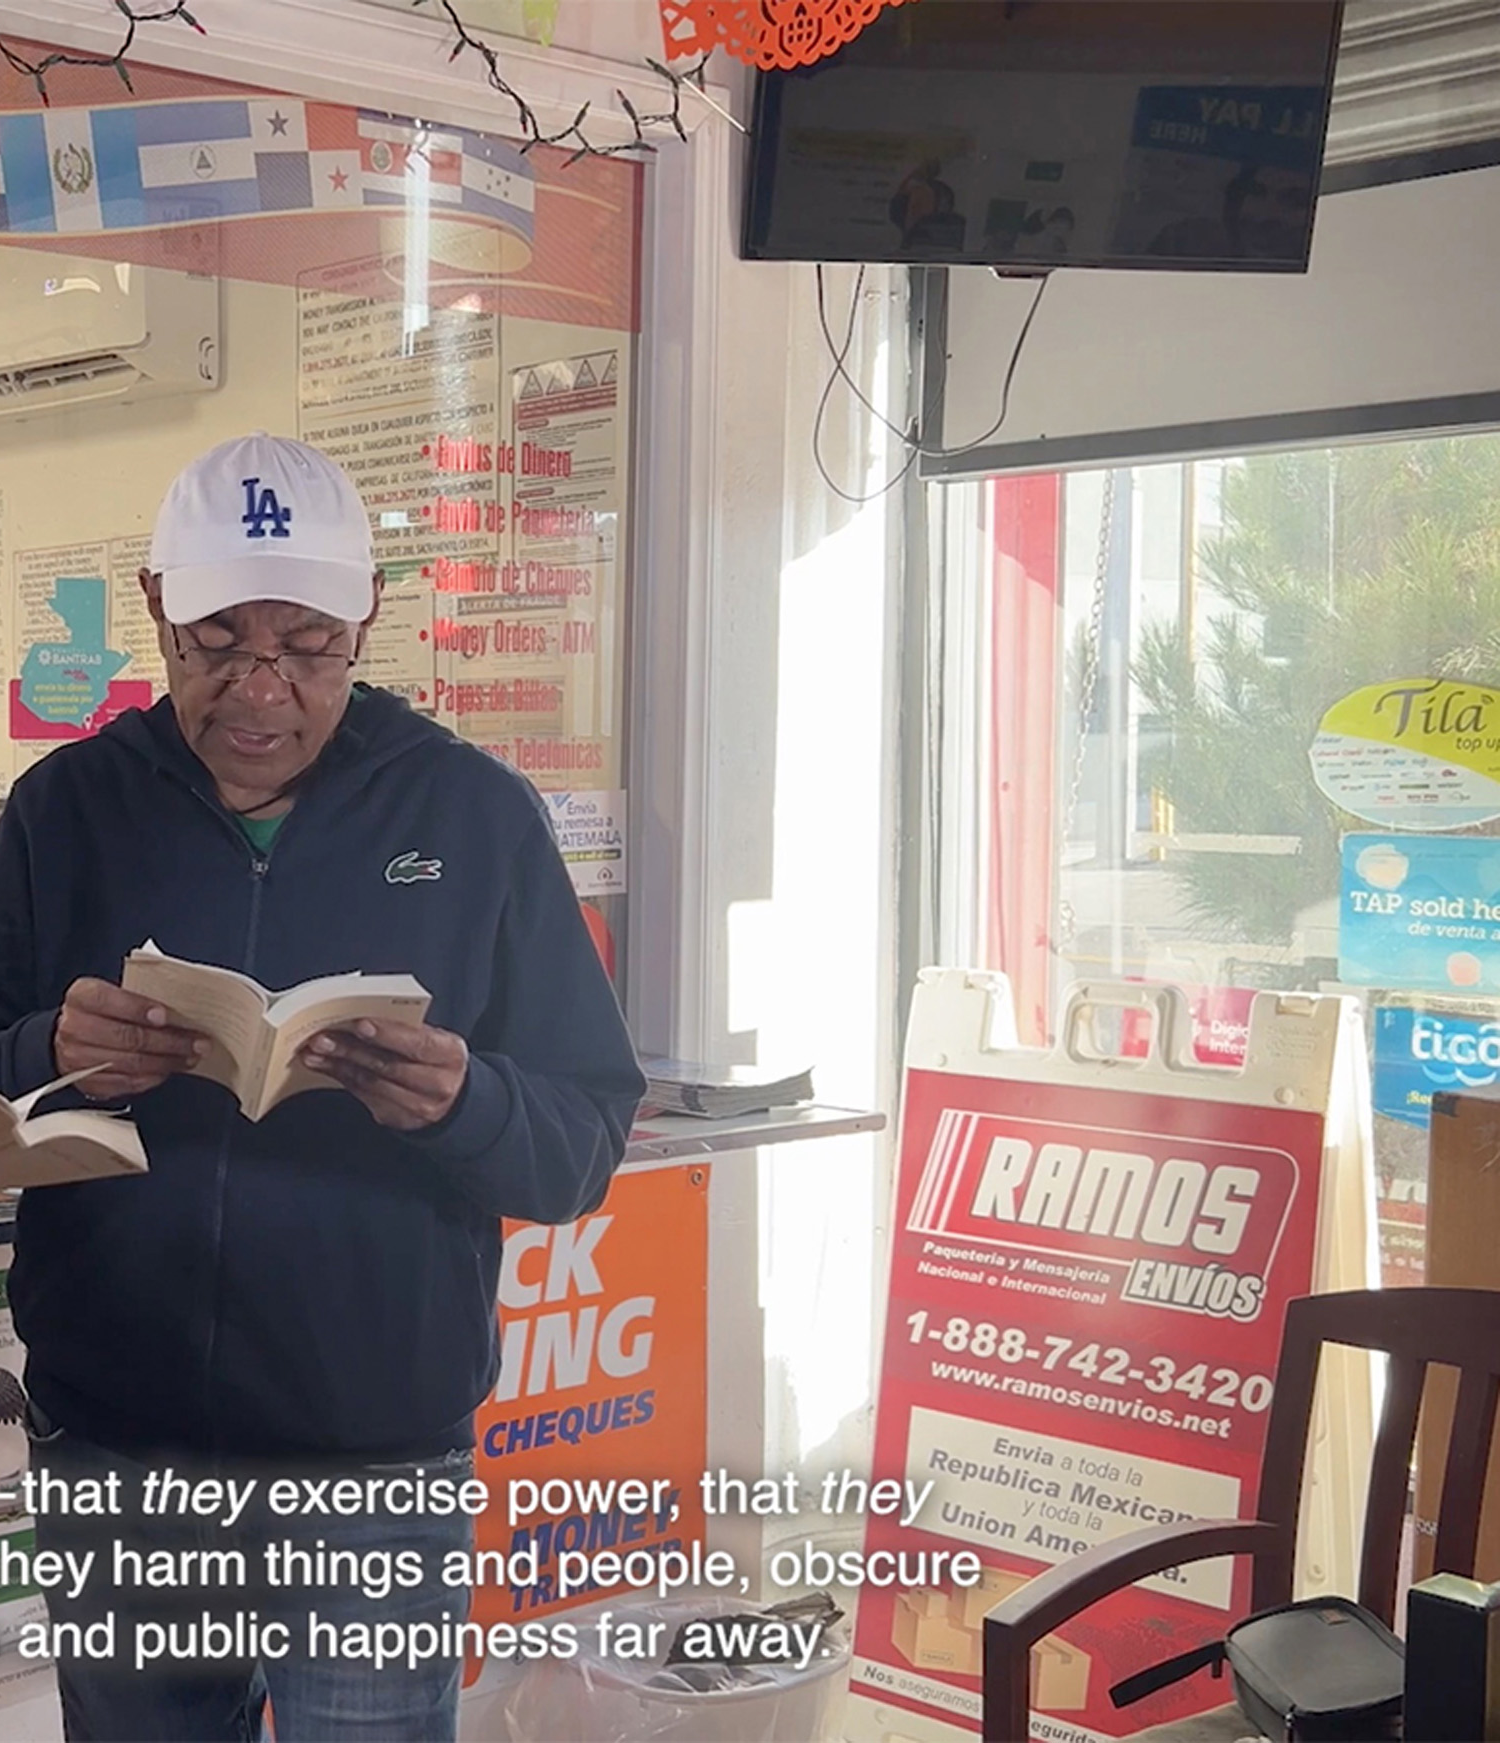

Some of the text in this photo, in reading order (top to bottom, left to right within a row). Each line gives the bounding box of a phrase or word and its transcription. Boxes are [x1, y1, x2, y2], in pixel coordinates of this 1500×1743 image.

[496, 440, 515, 474] de
[521, 441, 572, 477] Dinero
[242, 477, 291, 538] LA
[485, 499, 505, 534] de
[502, 559, 520, 594] de
[526, 560, 592, 596] Cheques
[495, 619, 546, 654] Orders
[562, 621, 595, 654] ATM
[1373, 677, 1488, 738] Tila
[1455, 737, 1482, 754] top
[1350, 891, 1403, 915] TAP
[1409, 896, 1466, 919] sold
[1407, 920, 1432, 937] de
[1436, 925, 1486, 940] venta
[970, 1135, 1261, 1257] RAMOS
[916, 1261, 1107, 1304] Nacional e Internacional
[1009, 1258, 1020, 1271] y
[1126, 1262, 1264, 1319] ENVÍOS
[905, 1309, 1273, 1414] 1-888-742-3420
[930, 1361, 1233, 1440] www.ramosenvios.net
[482, 1388, 656, 1459] CHEQUES
[993, 1437, 1144, 1488] Envia a toda la
[928, 1448, 1202, 1525] Republica Mexican
[941, 1502, 1017, 1539] Union
[1021, 1500, 1103, 1532] y toda la
[863, 1664, 980, 1714] Nos aseguramos
